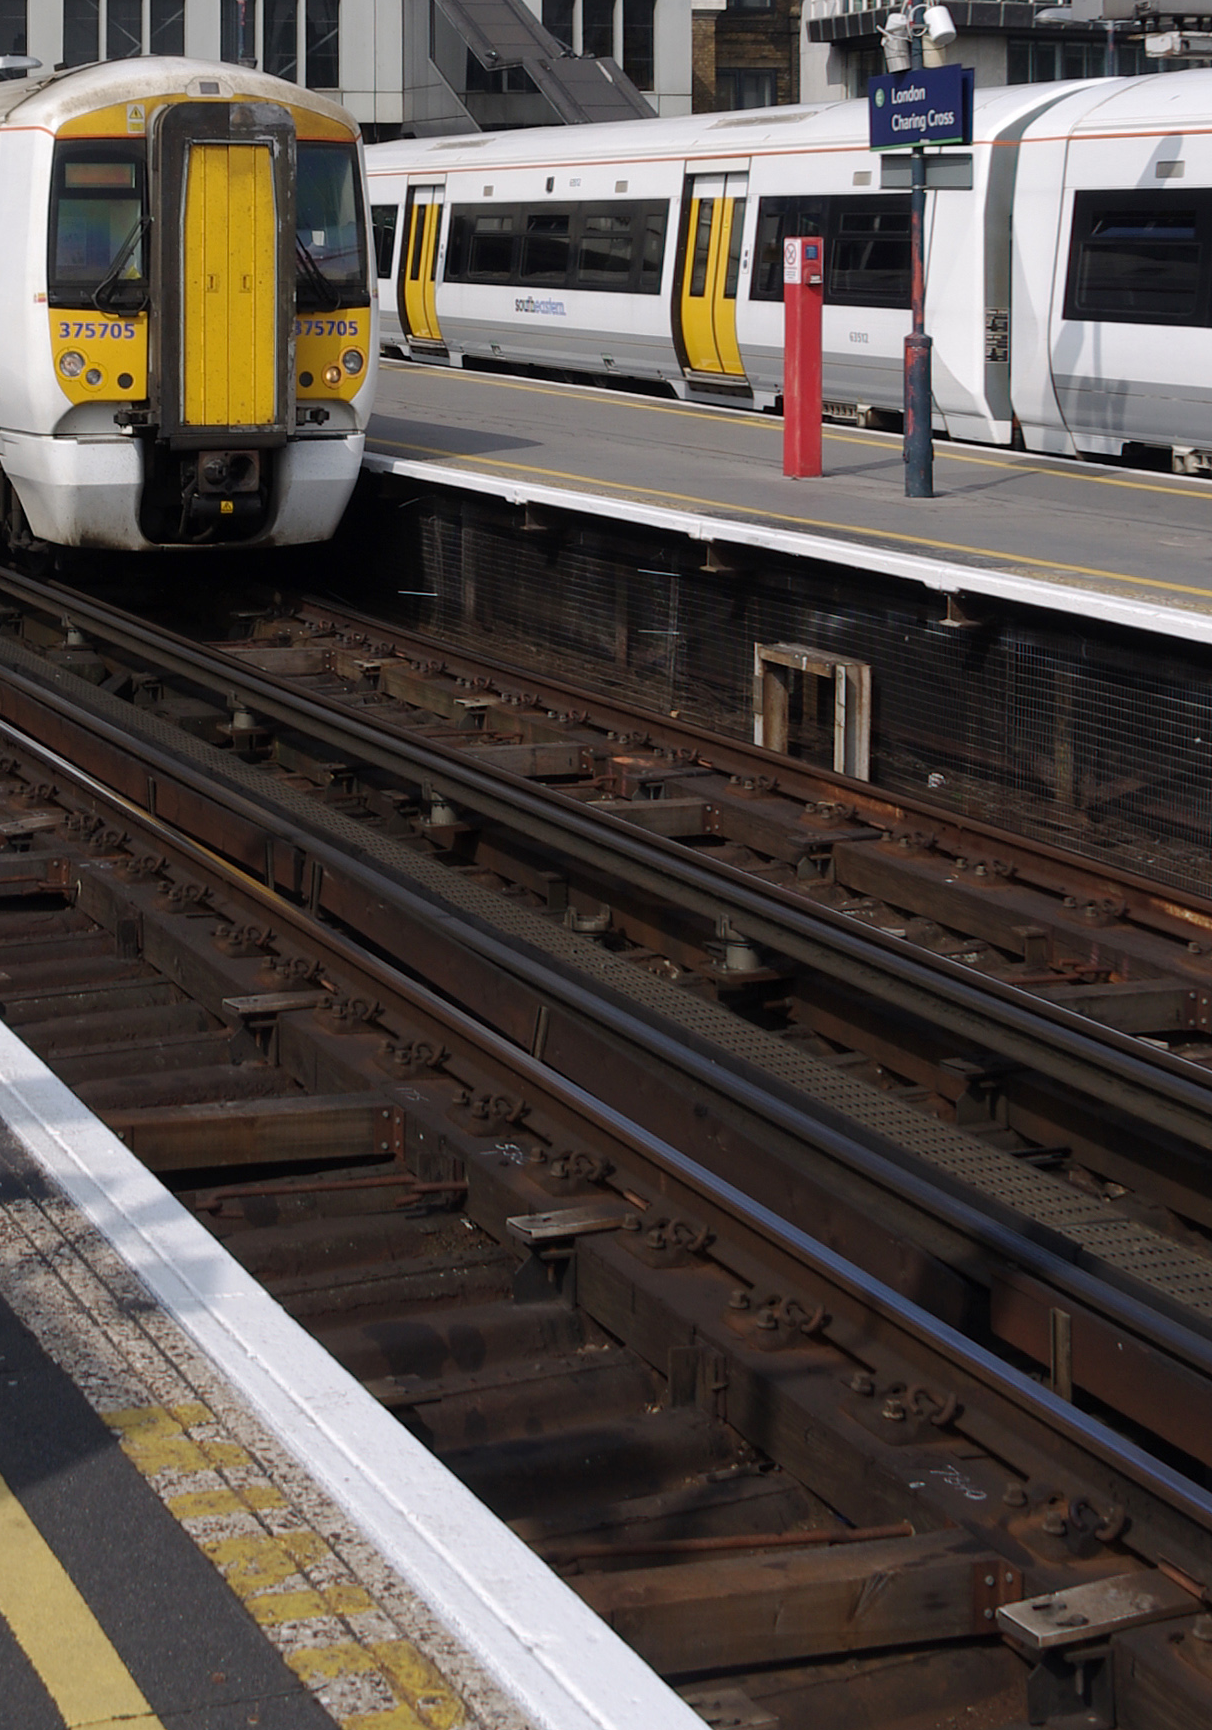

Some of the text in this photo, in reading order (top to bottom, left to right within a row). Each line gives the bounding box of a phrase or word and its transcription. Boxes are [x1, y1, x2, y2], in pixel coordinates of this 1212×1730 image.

[891, 85, 926, 105] London
[891, 109, 955, 132] Charing Cross
[59, 321, 136, 339] 375705
